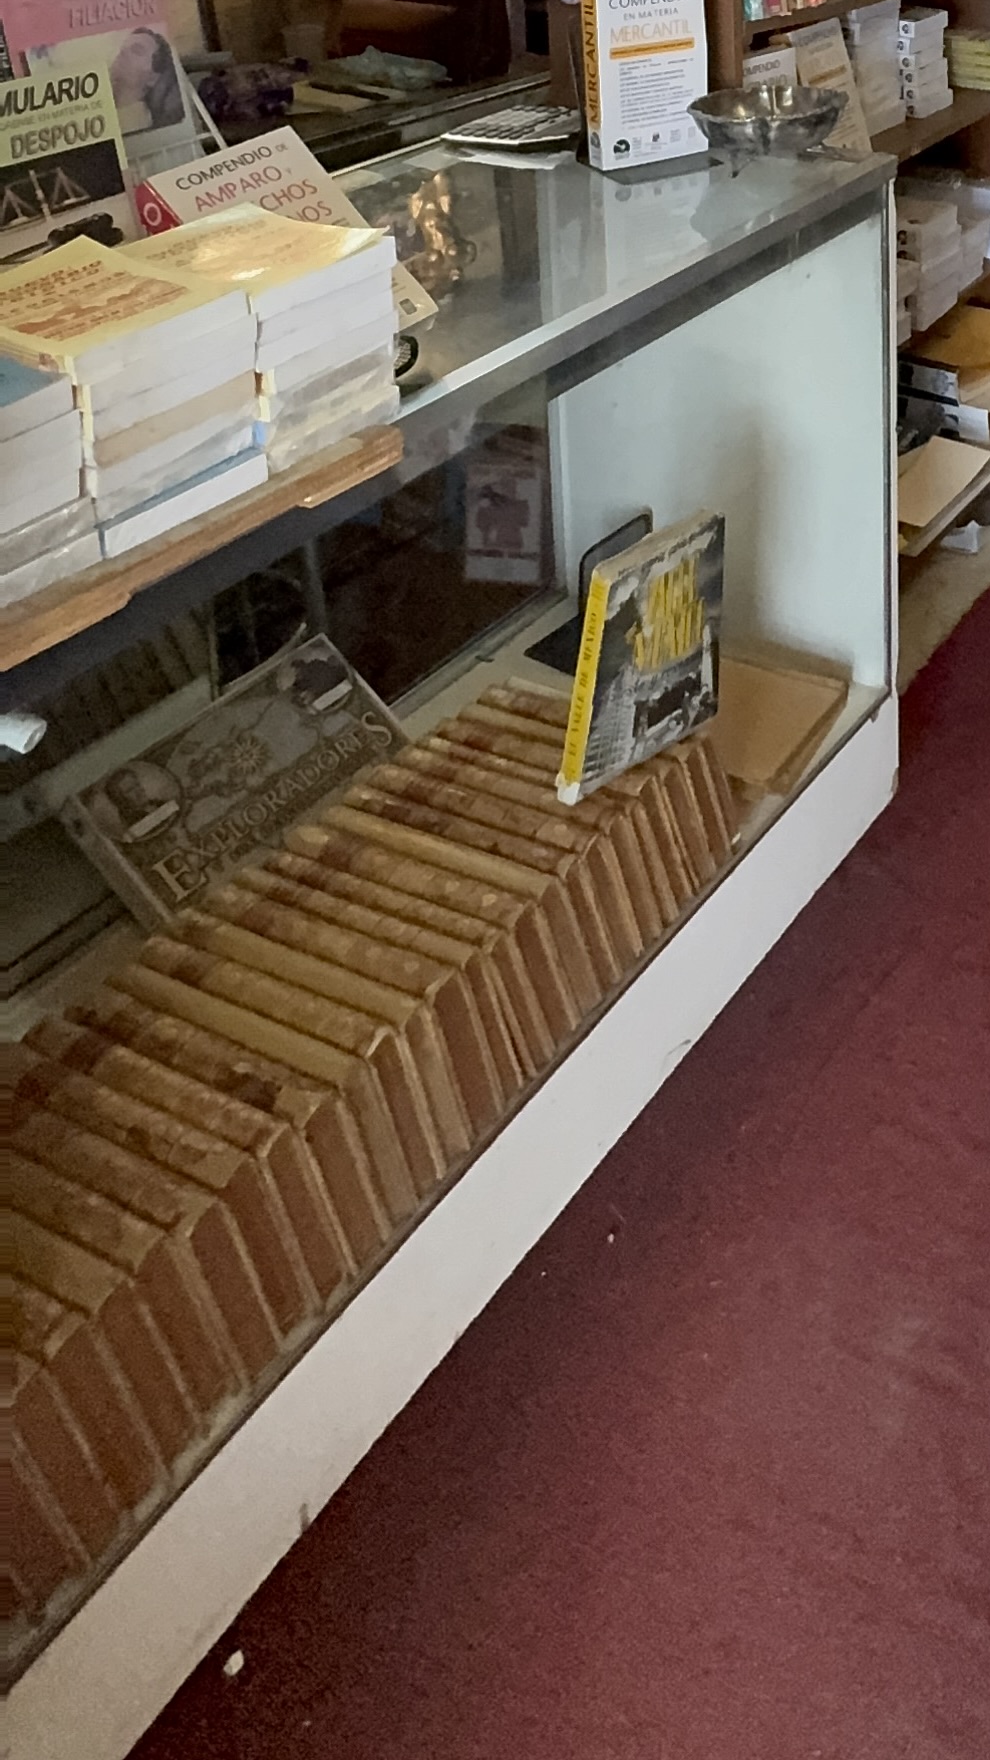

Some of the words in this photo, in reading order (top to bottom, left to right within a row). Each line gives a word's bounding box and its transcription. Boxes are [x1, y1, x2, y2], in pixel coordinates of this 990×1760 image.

[610, 19, 693, 44] MERCANTIL
[623, 12, 637, 21] EN
[638, 7, 679, 20] MATERIA
[584, 0, 600, 124] MERCANTIL
[0, 71, 99, 119] MULARIO
[10, 114, 106, 160] DESPOJO
[175, 144, 273, 191] COMPENDIO
[193, 165, 283, 213] AMPARO
[259, 178, 318, 213] CHOS
[151, 710, 392, 904] EXPLORADORES
